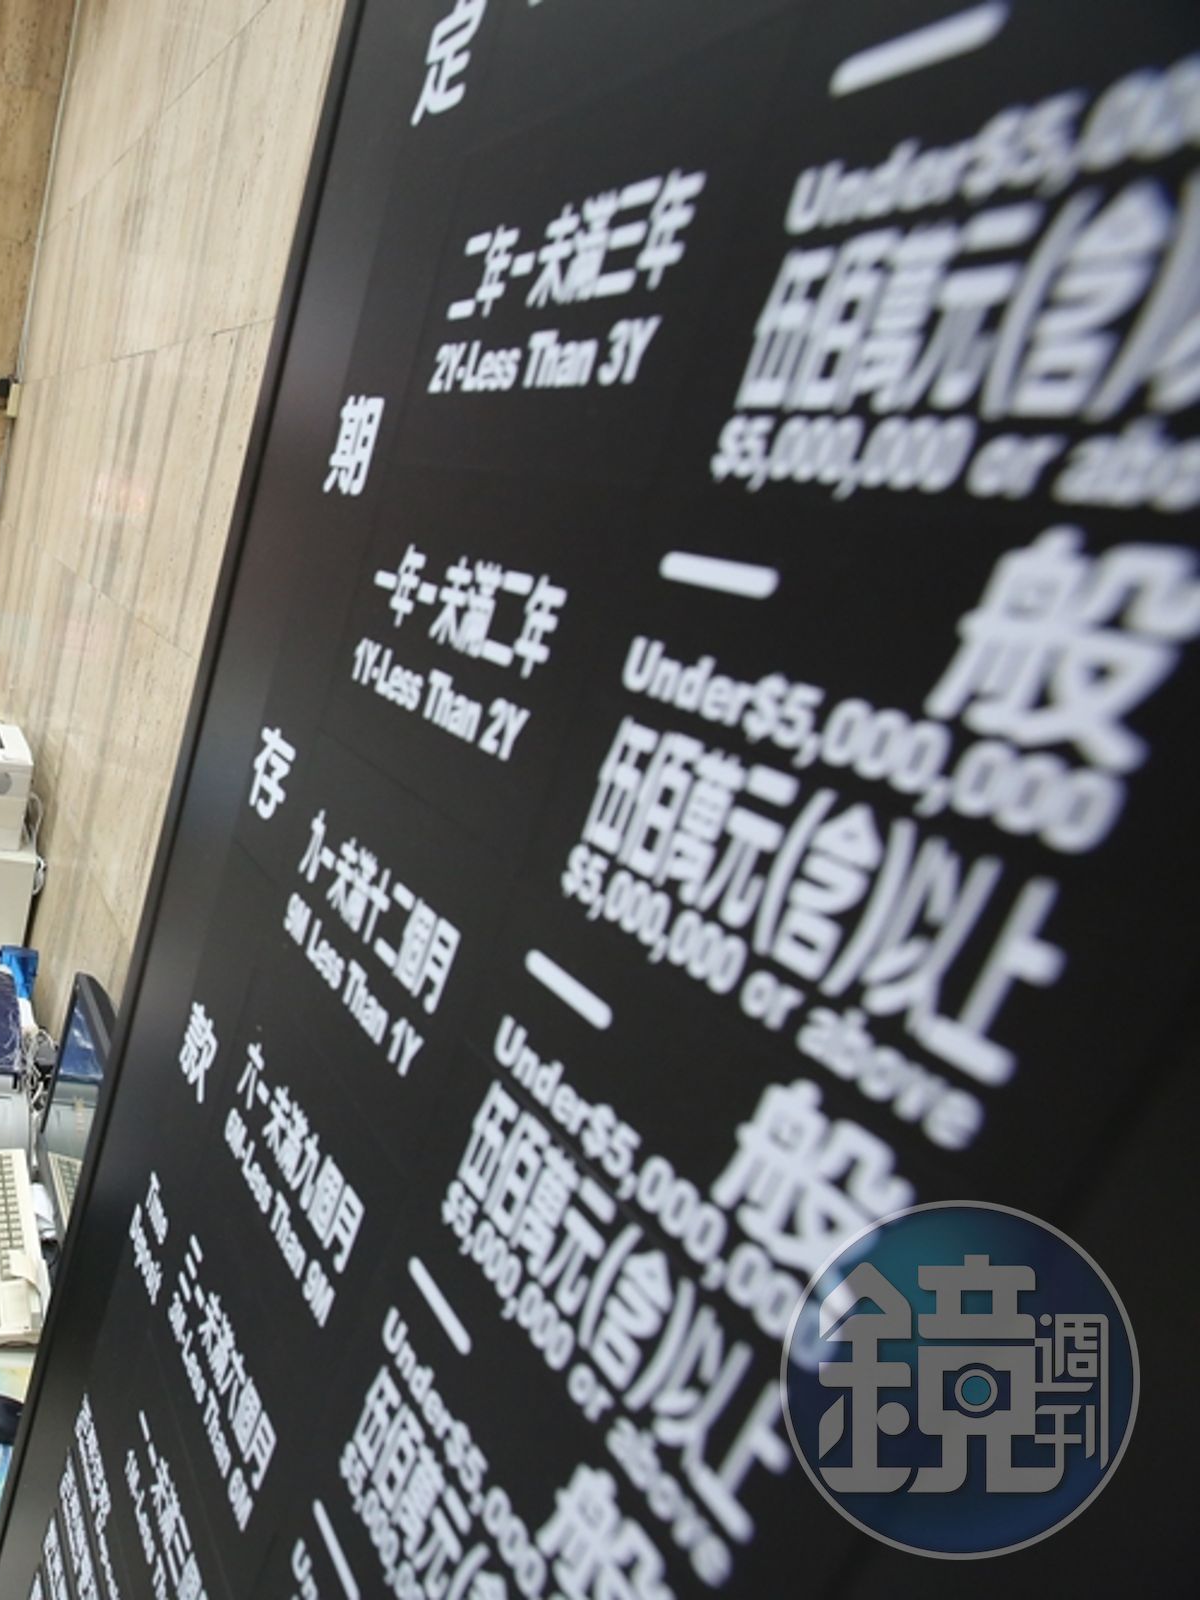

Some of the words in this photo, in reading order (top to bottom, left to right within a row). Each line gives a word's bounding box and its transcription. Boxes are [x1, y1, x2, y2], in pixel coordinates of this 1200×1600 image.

[734, 165, 1200, 422] 伍佰萬元(含)
[522, 329, 598, 389] Than
[596, 314, 663, 386] 3Y
[323, 395, 385, 496] 期
[711, 414, 978, 500] $5,000,000
[966, 433, 1066, 500] or
[422, 668, 483, 743] Than
[477, 697, 531, 762] 2Y
[622, 635, 1126, 855] Under$5,000,000
[249, 727, 296, 820] 存
[342, 959, 388, 1045] Than
[387, 1017, 424, 1077] 1Y
[561, 843, 747, 994] $5,000,000
[740, 970, 805, 1031] or
[797, 1006, 986, 1151] above
[179, 1001, 218, 1104] 款
[270, 1190, 306, 1280] Than
[441, 1180, 574, 1371] $5,000,000
[567, 1363, 614, 1422] or
[382, 1306, 547, 1600] Under$5,000
